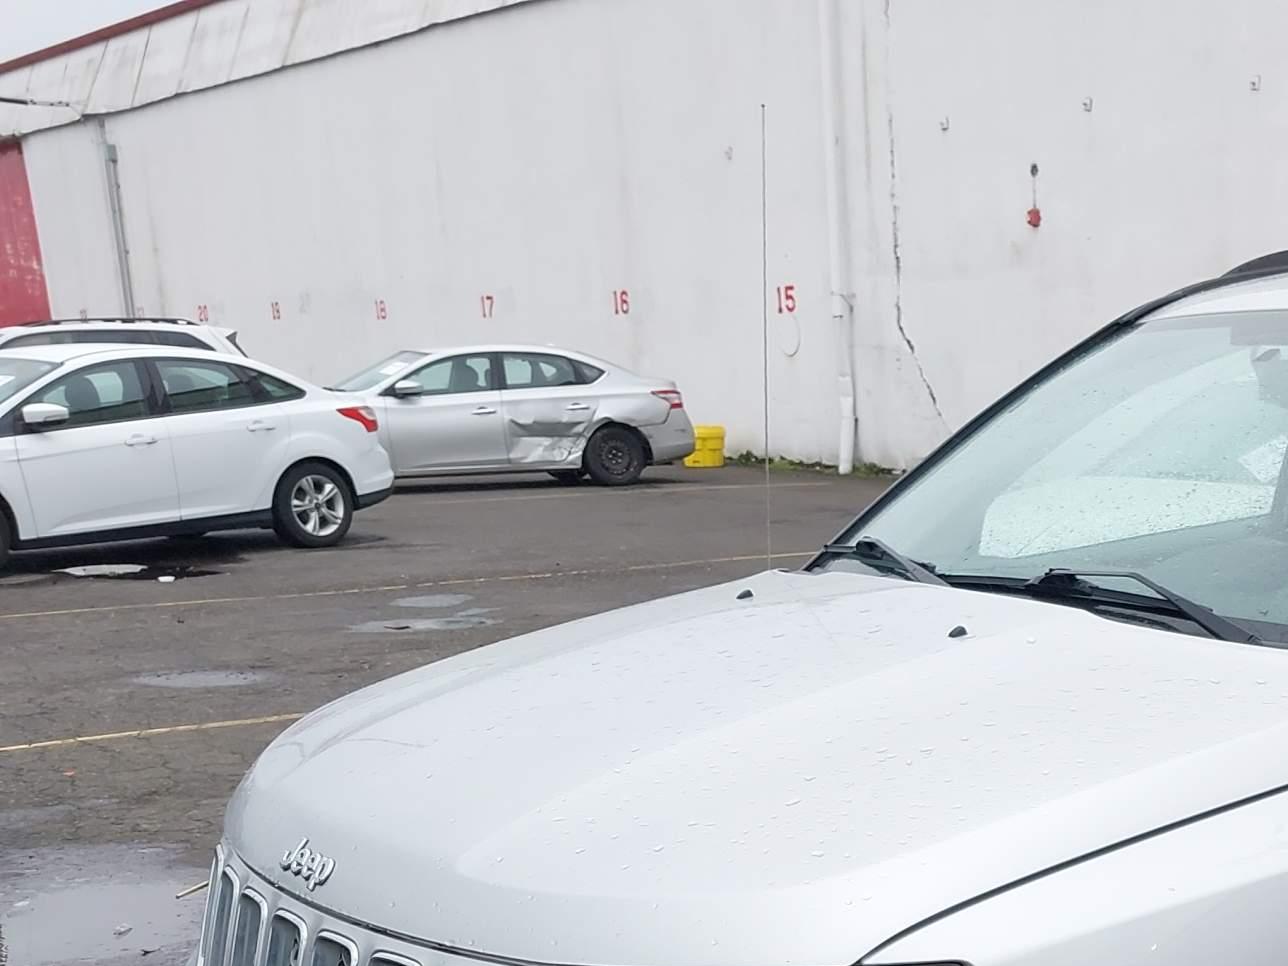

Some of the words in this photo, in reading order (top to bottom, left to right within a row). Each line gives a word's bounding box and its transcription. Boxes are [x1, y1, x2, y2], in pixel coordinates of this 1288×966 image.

[375, 300, 387, 320] 18
[480, 295, 494, 318] 17
[613, 289, 629, 315] 16
[777, 285, 796, 314] 15
[280, 837, 336, 893] Jeep
